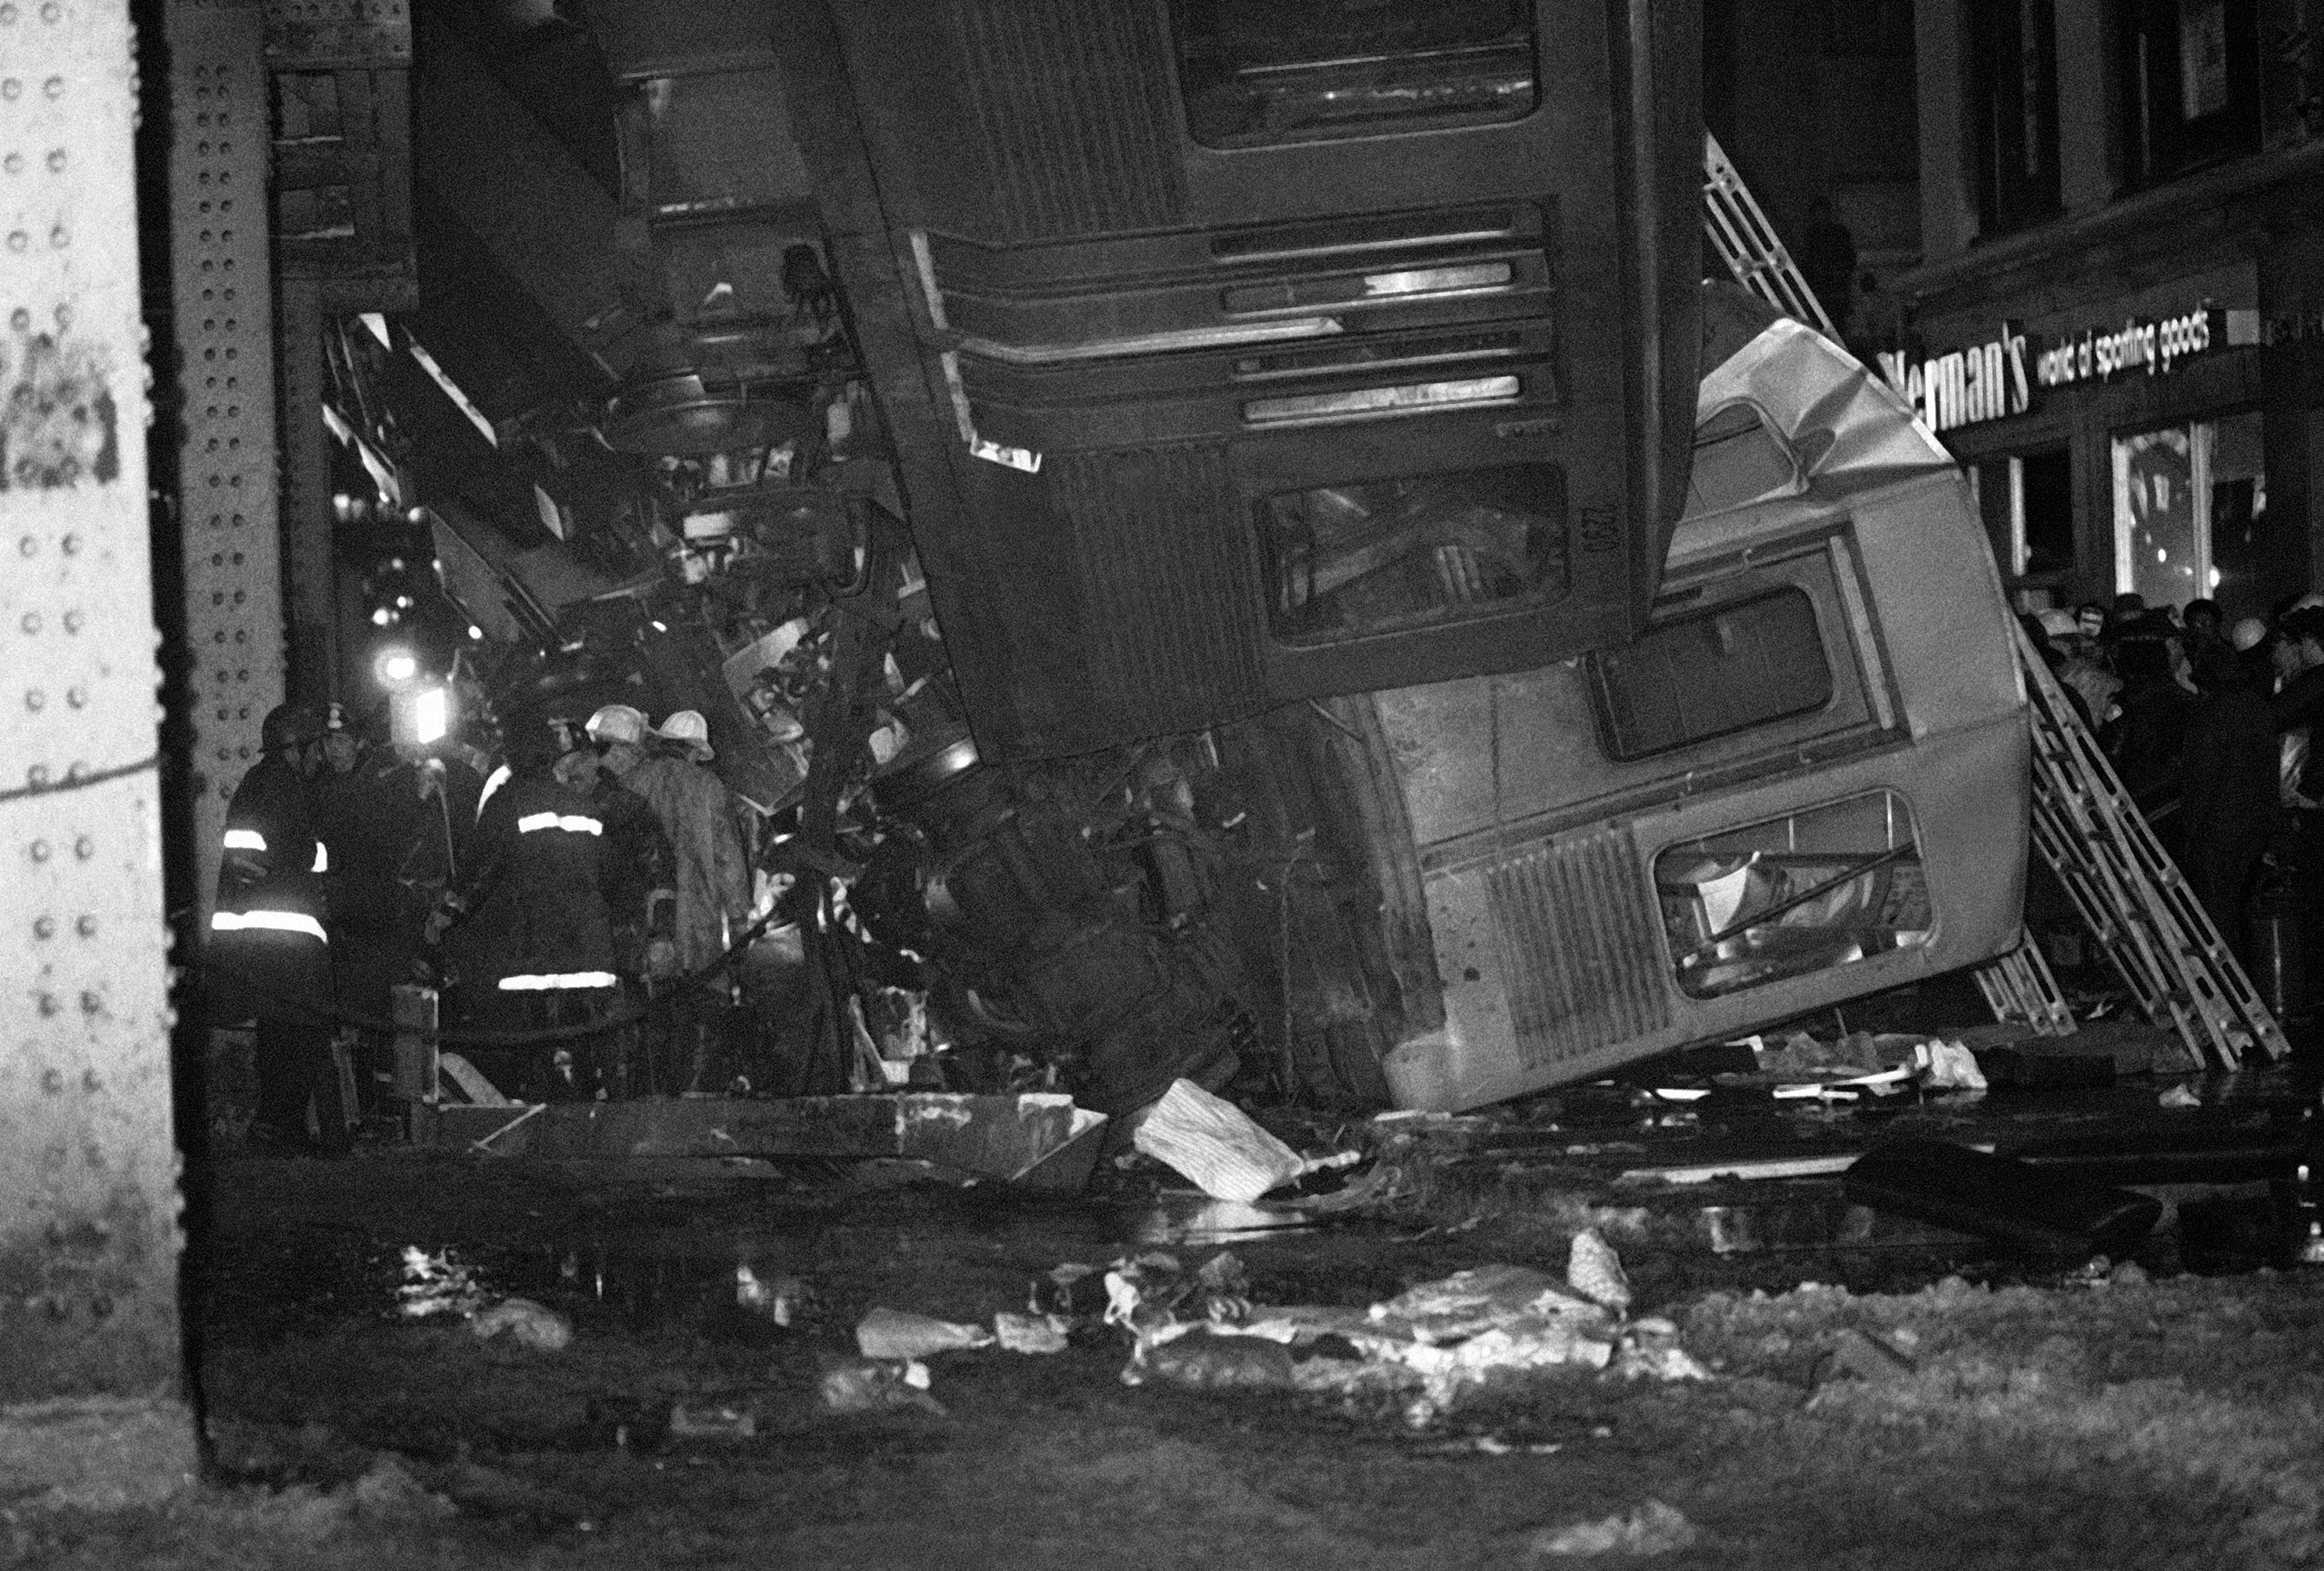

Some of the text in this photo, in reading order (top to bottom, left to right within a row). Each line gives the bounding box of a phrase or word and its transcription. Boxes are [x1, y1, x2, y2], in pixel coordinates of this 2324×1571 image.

[2037, 335, 2075, 386] world
[2078, 330, 2092, 378] of
[2095, 318, 2156, 382] sporting
[2160, 303, 2210, 373] goods
